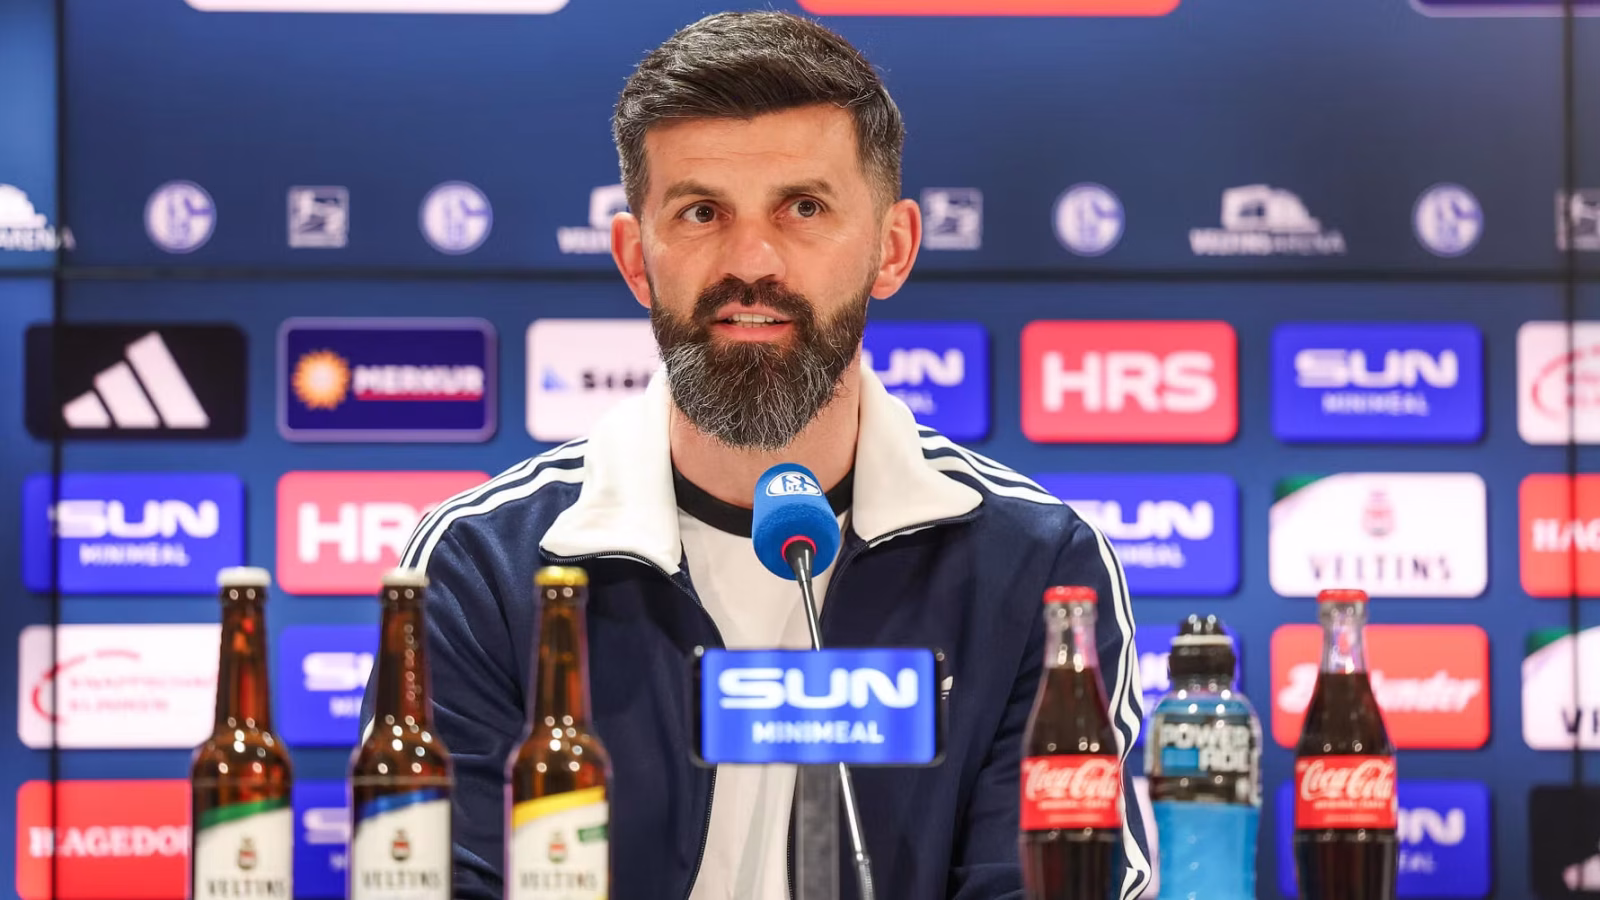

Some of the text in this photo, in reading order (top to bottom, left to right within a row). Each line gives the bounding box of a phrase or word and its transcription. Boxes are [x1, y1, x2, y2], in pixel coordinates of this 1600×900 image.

[355, 365, 485, 395] MERKUR
[862, 348, 966, 387] UN
[1042, 351, 1218, 412] HRS
[1295, 348, 1459, 388] SUN
[50, 499, 219, 538] SUN
[1308, 555, 1452, 580] VELTINS
[718, 668, 918, 709] SUN
[752, 721, 885, 744] MINIMEAL
